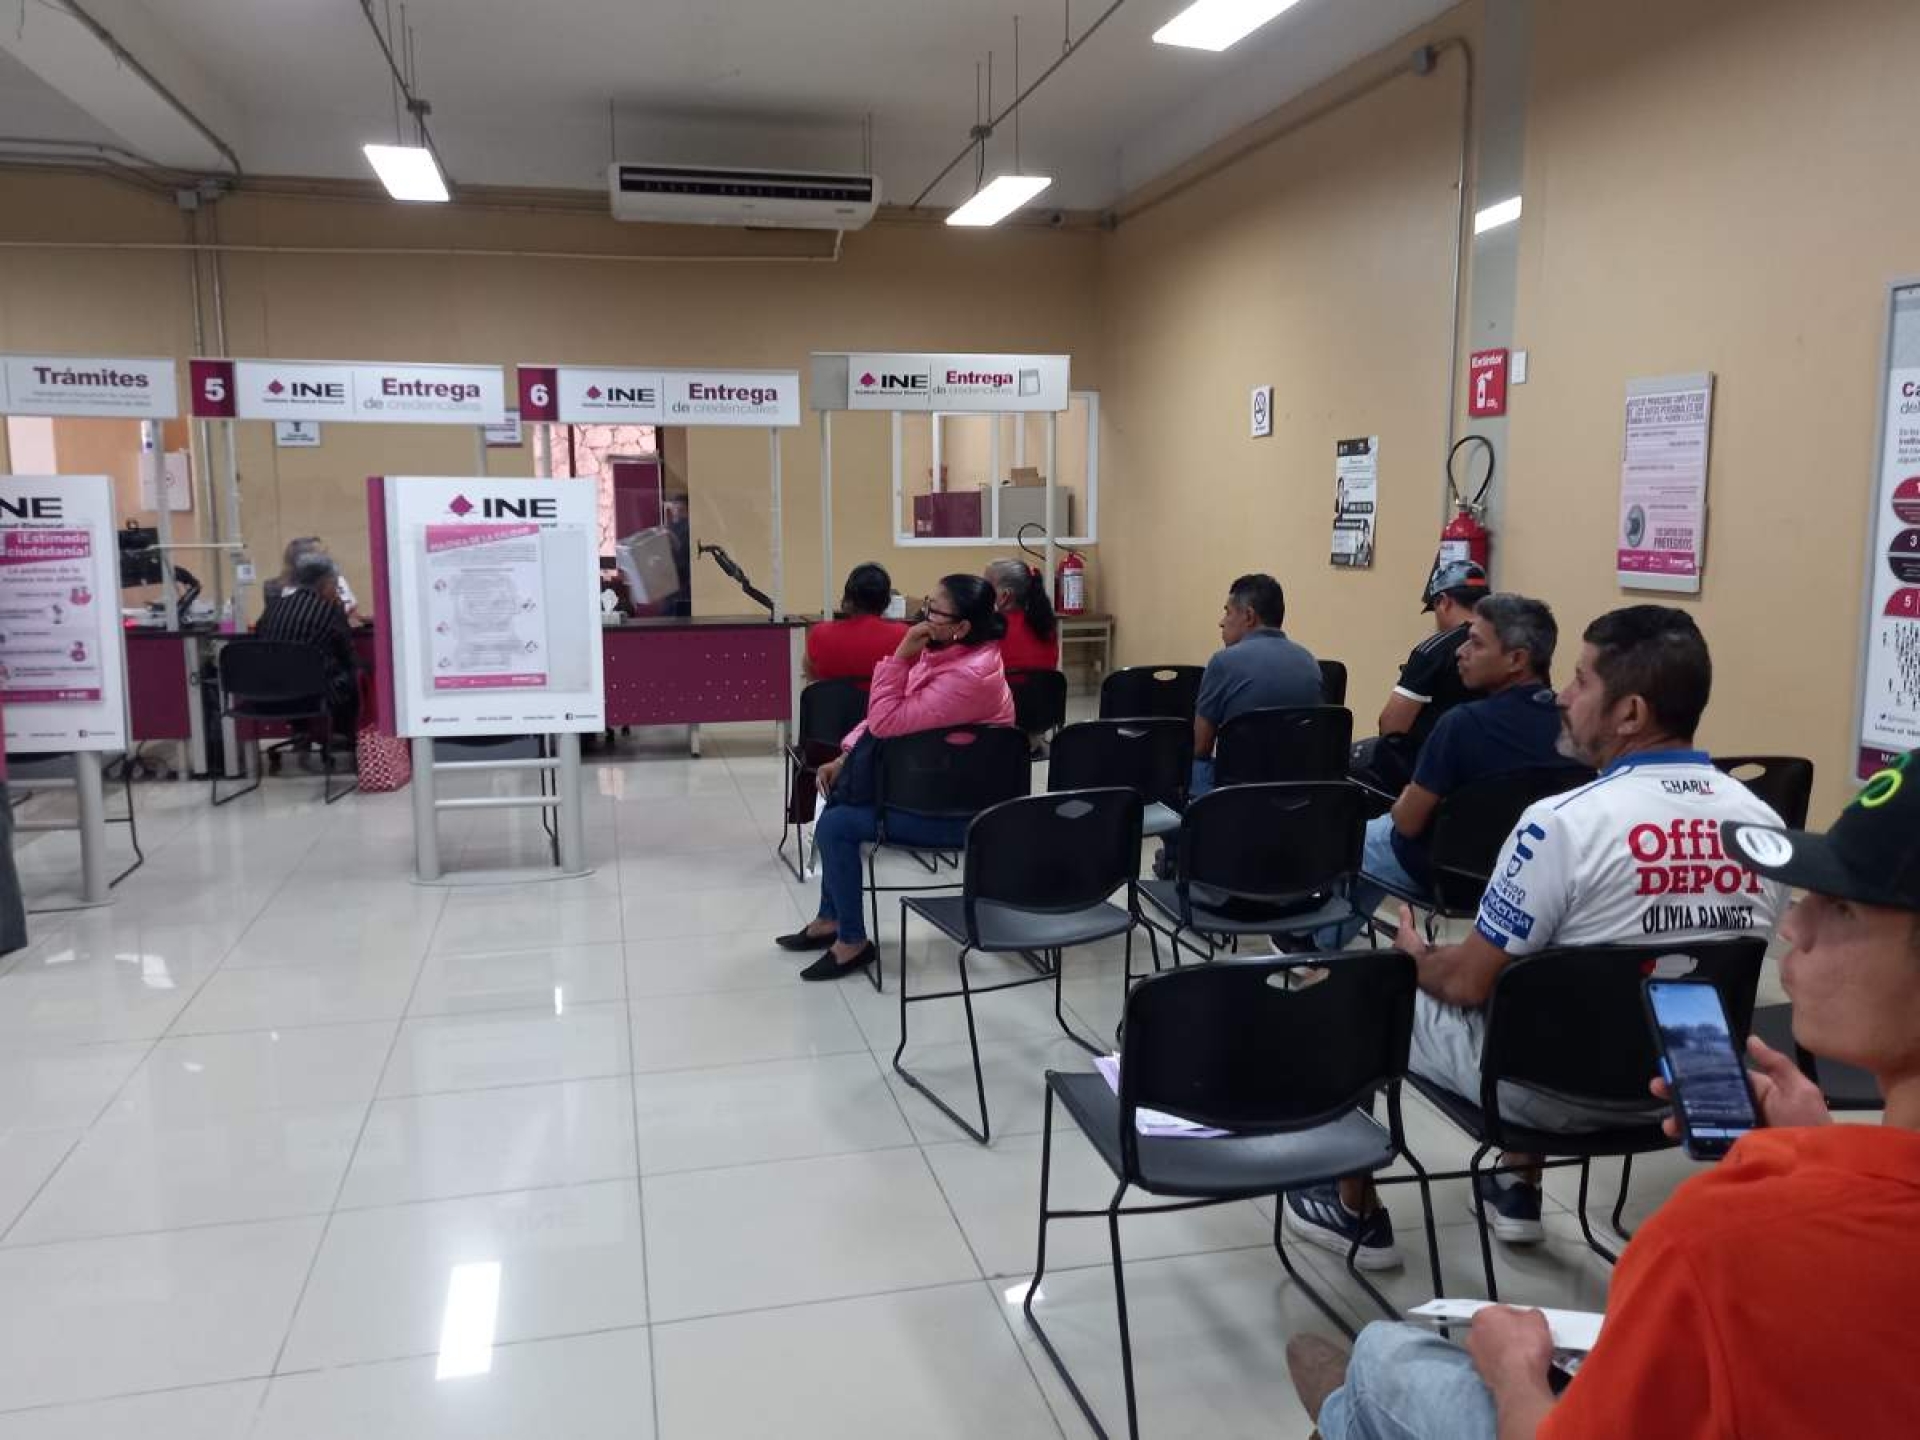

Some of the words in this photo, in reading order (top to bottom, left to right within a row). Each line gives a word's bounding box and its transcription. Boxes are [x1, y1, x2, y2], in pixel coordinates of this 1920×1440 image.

[33, 366, 149, 388] Trámites
[881, 373, 929, 388] INE
[946, 370, 1014, 387] Entrega
[204, 377, 225, 401] 5
[291, 382, 345, 398] INE
[382, 377, 481, 402] Entrega
[530, 383, 549, 407] 6
[607, 388, 655, 402] INE
[689, 383, 778, 405] Entrega
[363, 398, 385, 410] de
[672, 400, 691, 413] de
[0, 497, 63, 518] NE
[482, 498, 558, 518] INE
[1910, 535, 1918, 547] 3
[1904, 595, 1912, 608] 5
[1661, 779, 1714, 794] CHARLY
[1628, 818, 1738, 863] Offi
[1636, 865, 1764, 896] DEPOT
[1642, 905, 1693, 934] OLIVIA
